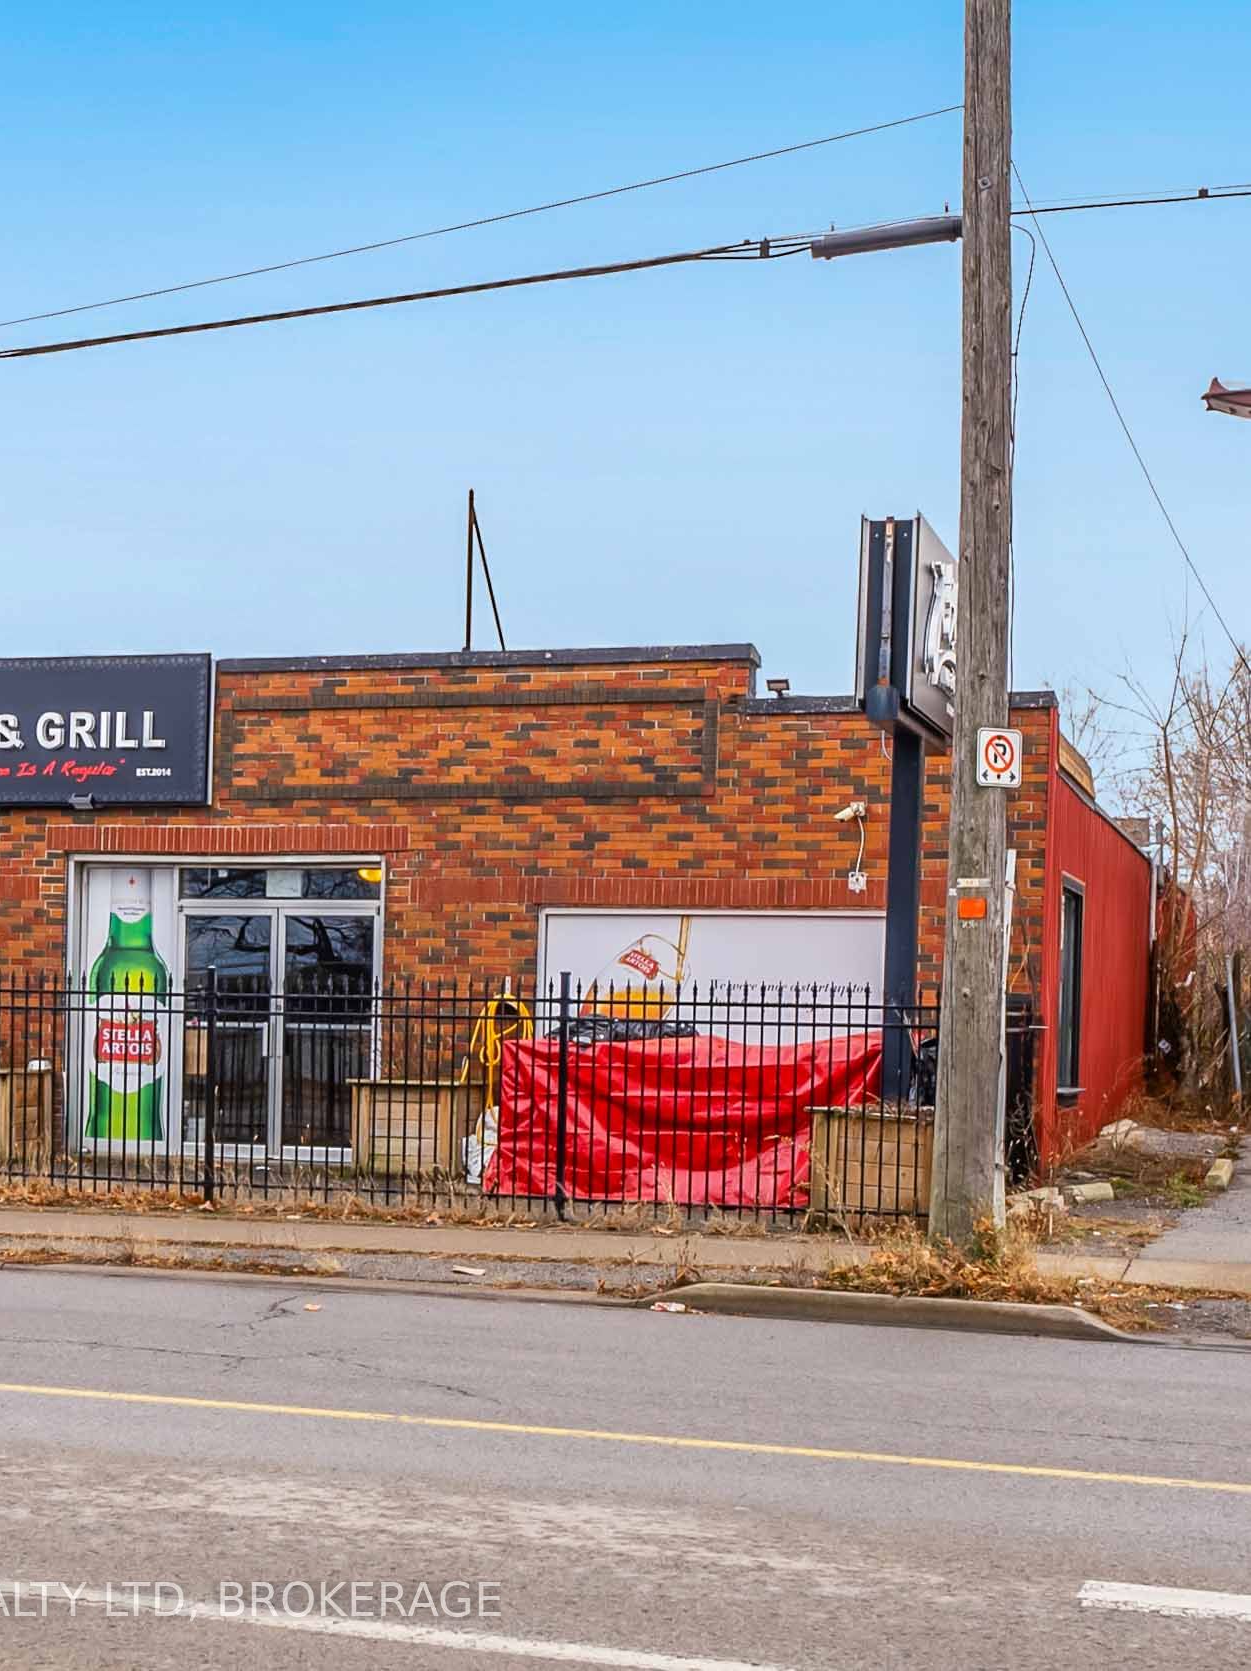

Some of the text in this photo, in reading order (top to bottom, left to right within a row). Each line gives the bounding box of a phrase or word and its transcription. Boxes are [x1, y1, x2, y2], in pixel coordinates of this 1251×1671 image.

[35, 710, 167, 750] GRILL
[16, 763, 36, 778] Is
[41, 760, 55, 777] A
[101, 1041, 153, 1056] ARTOIS
